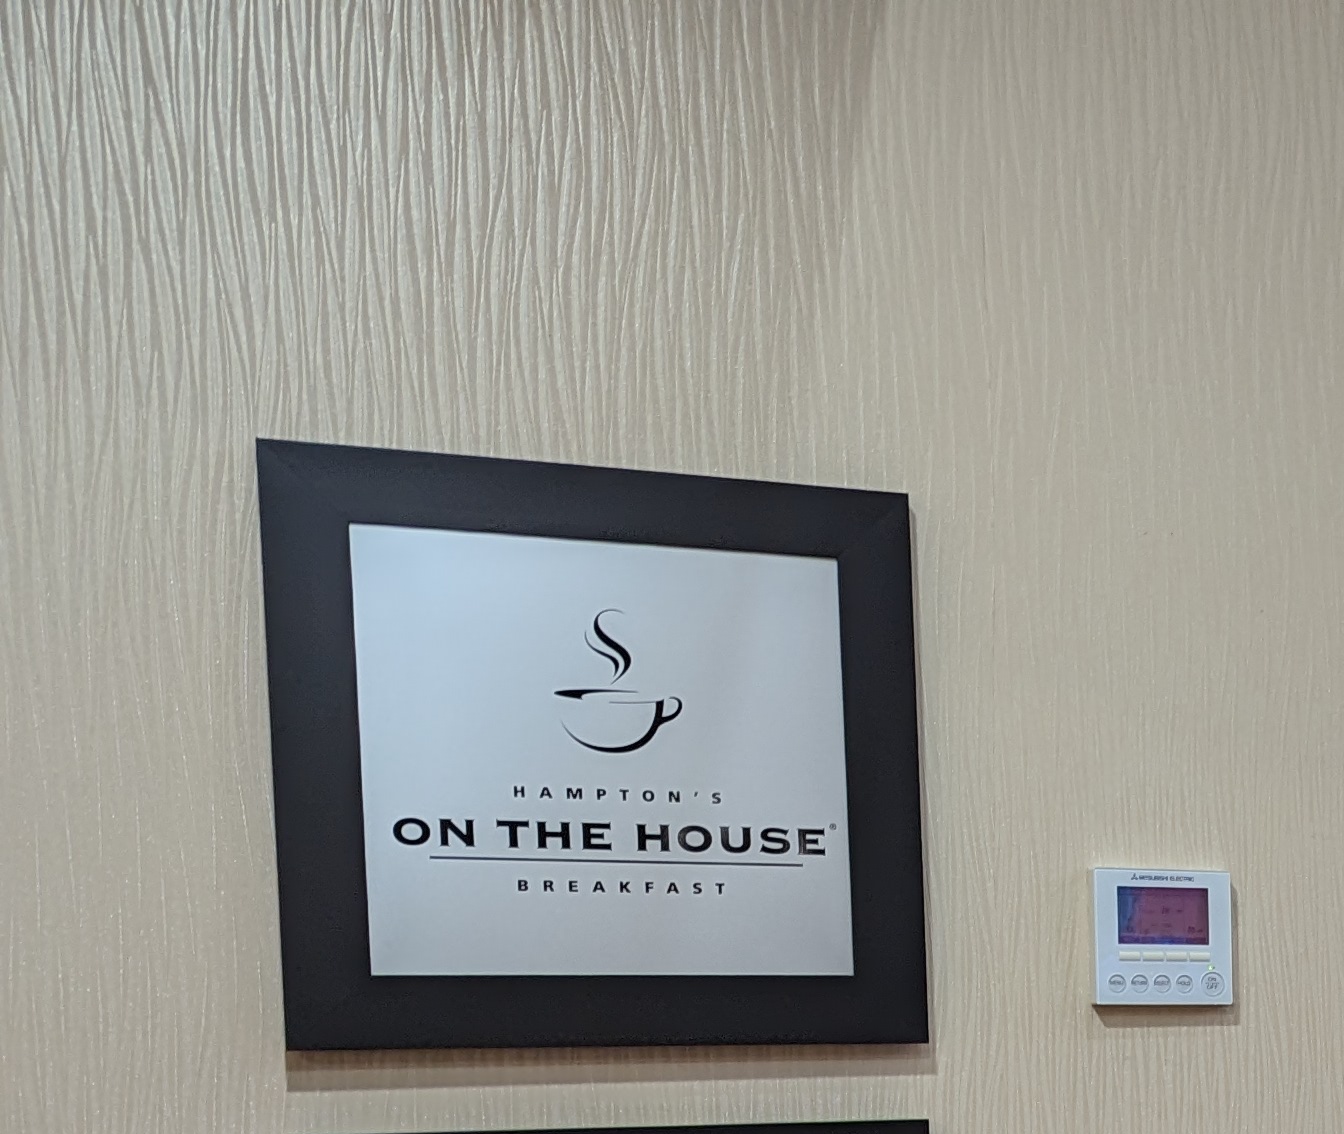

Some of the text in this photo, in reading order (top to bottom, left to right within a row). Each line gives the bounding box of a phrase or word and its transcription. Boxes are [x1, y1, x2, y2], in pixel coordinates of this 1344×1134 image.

[513, 785, 723, 805] HAMPTON'S
[392, 817, 476, 847] ON
[495, 819, 613, 852] THE
[517, 879, 726, 896] BREAKFAST
